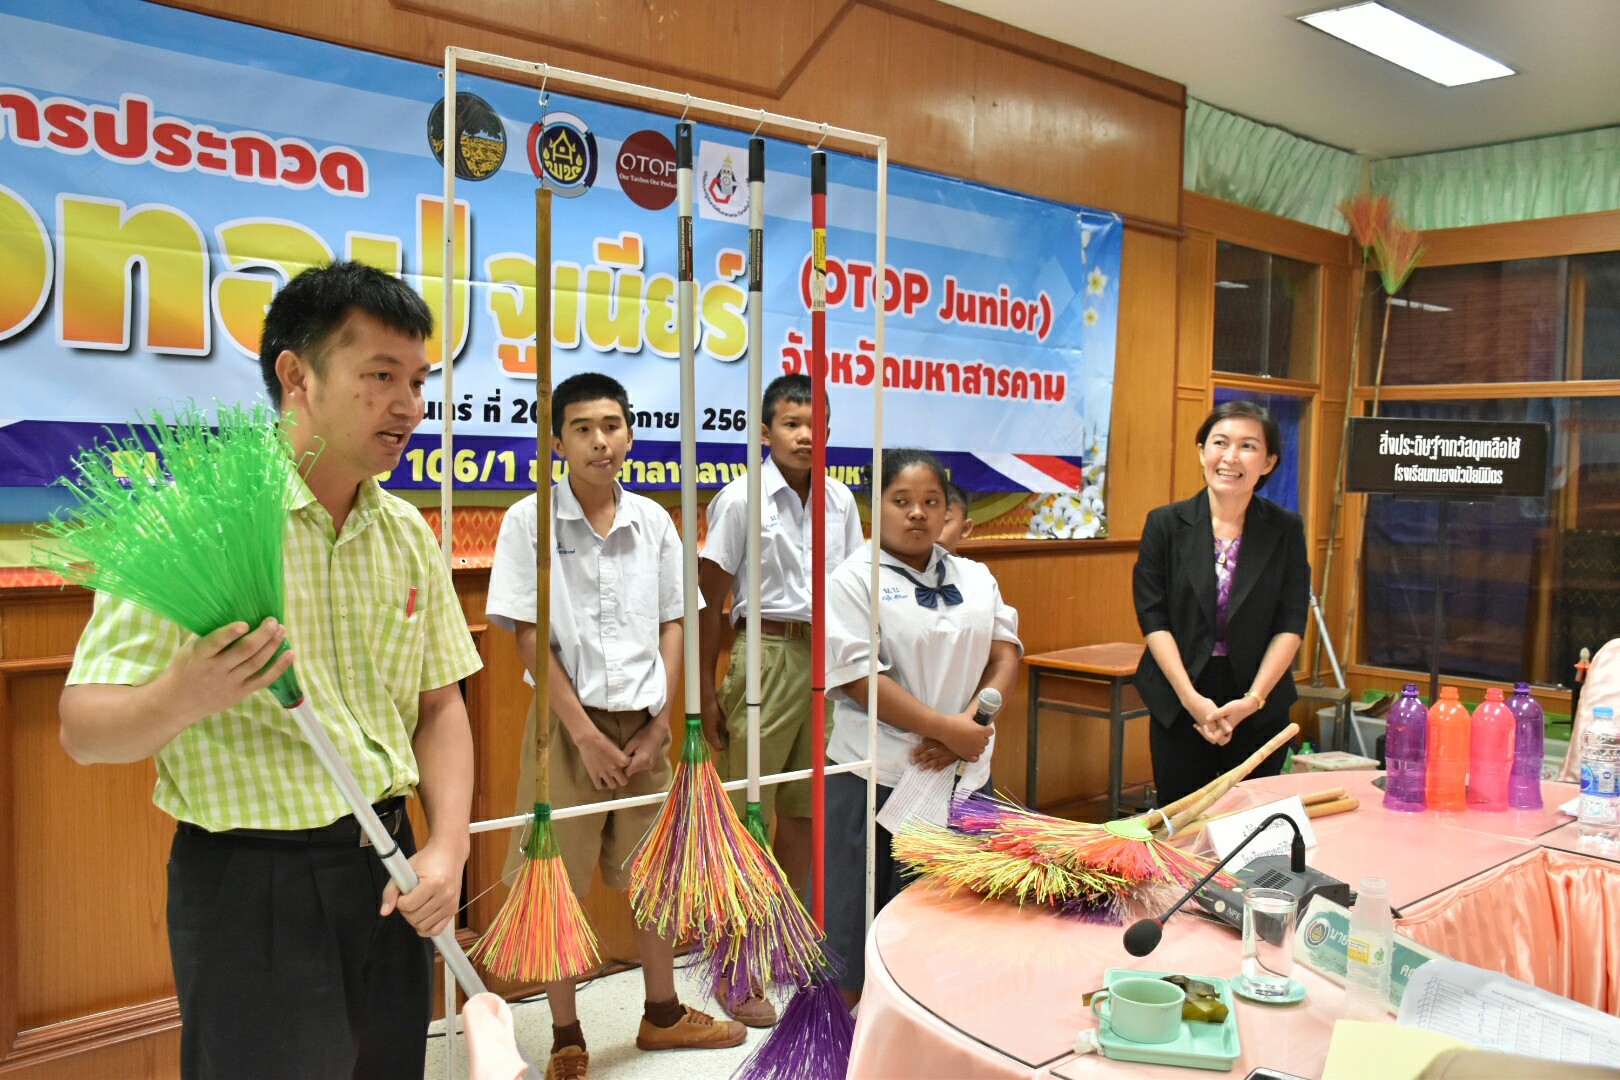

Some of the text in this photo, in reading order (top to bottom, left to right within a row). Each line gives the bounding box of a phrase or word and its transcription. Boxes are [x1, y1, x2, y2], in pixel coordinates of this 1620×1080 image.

[620, 152, 677, 177] OTOP
[801, 255, 928, 315] (OTOP
[940, 279, 1051, 340] Junior)
[405, 448, 516, 483] 106/1
